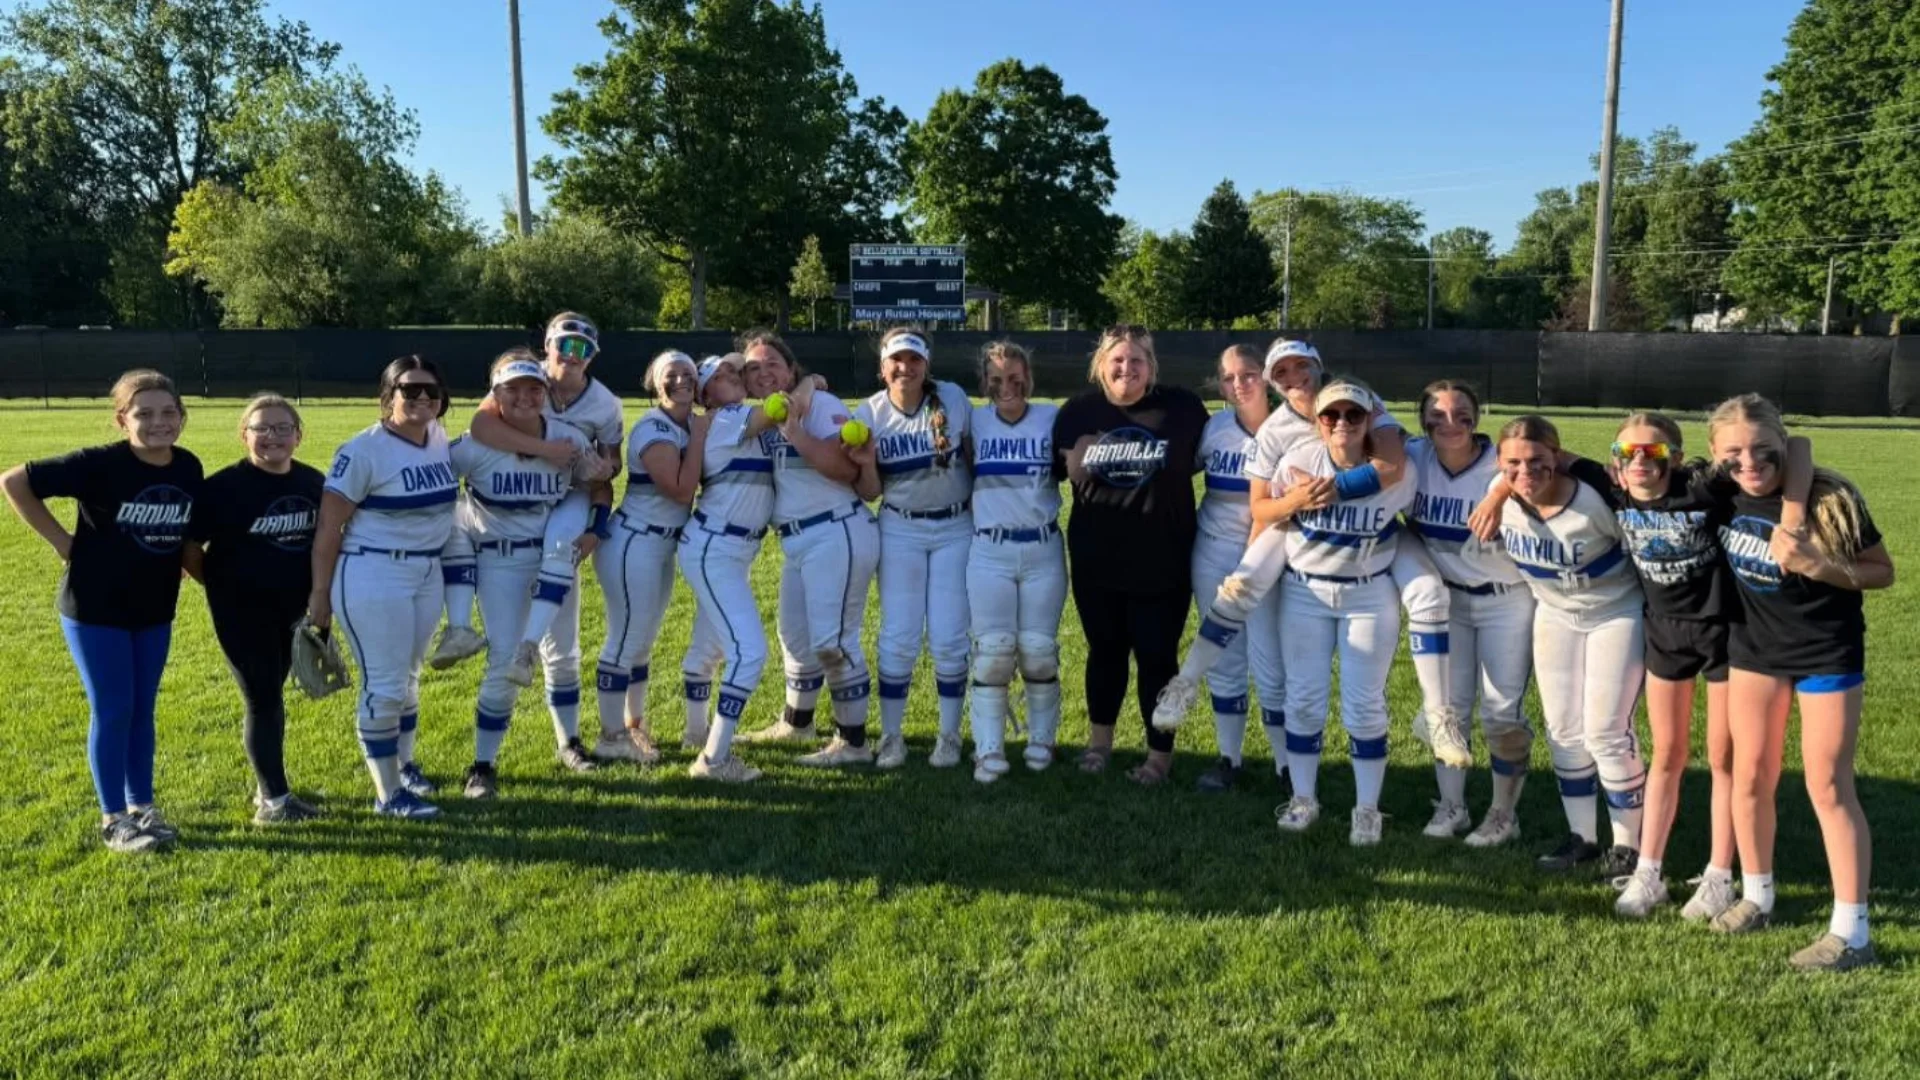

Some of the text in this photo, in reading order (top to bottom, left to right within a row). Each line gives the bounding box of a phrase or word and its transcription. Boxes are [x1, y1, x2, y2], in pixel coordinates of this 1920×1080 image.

[936, 282, 960, 292] GUEST
[856, 309, 961, 321] Mary Rutan Hospital
[980, 437, 1049, 460] DANVILLE
[1082, 440, 1168, 464] DANVILLE
[492, 471, 563, 495] DANVILLE
[1505, 526, 1586, 567] DANVILLE
